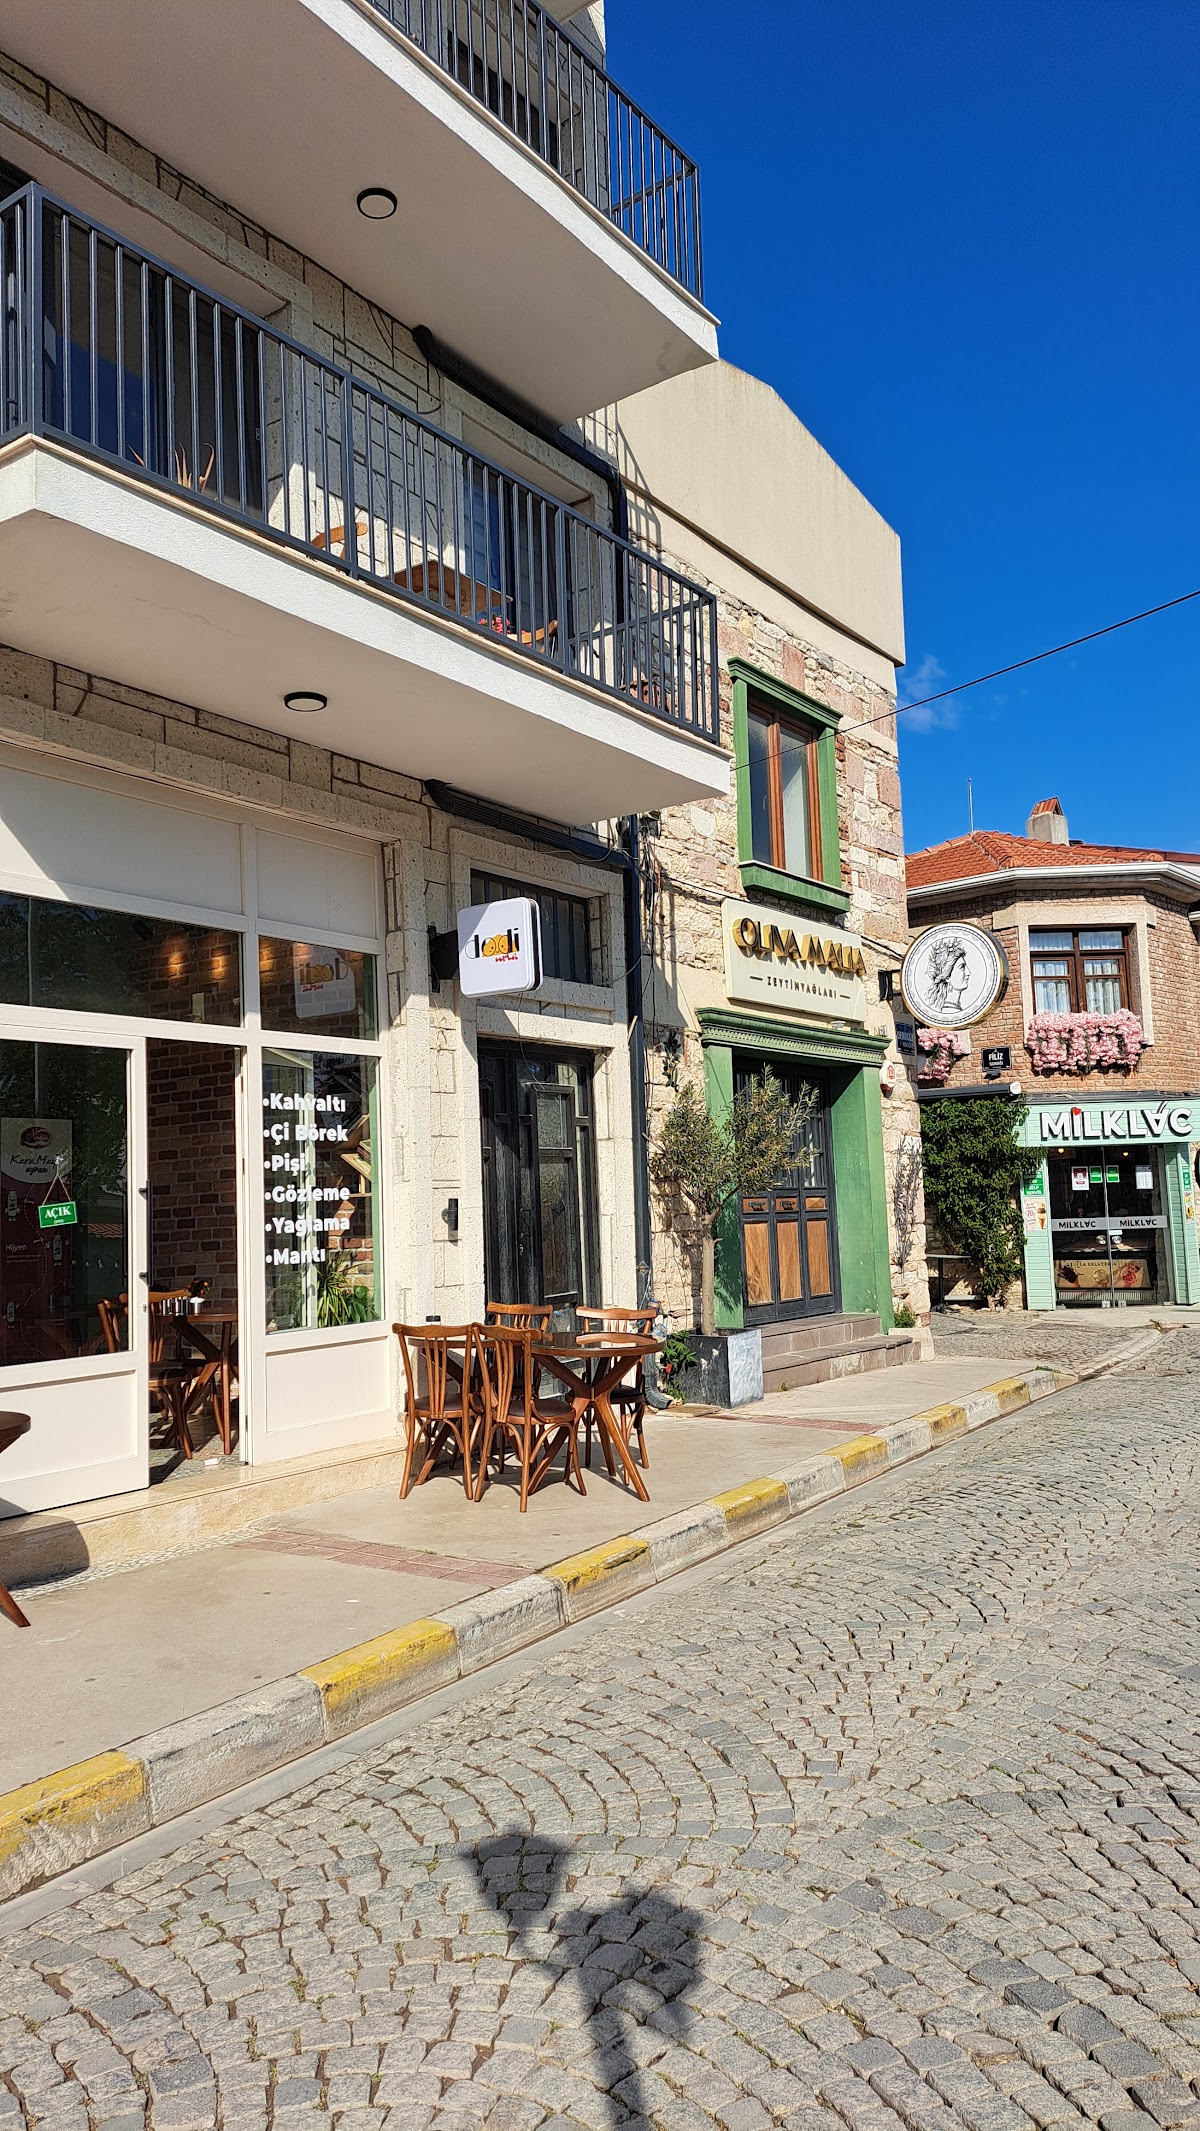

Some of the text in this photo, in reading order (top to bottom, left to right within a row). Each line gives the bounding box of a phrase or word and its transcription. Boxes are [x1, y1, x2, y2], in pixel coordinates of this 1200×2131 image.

[767, 976, 837, 999] ZEYTİNYAĞLARI
[988, 1052, 1004, 1061] FİLİZ
[270, 1093, 346, 1112] Kahvaltı
[270, 1122, 349, 1145] Çi Börek
[271, 1152, 306, 1176] Pişi
[272, 1184, 350, 1202] Gözleme
[44, 1206, 72, 1220] AÇIK
[272, 1215, 350, 1237] Yağlama
[5, 1243, 27, 1253] Hijyen
[273, 1248, 326, 1266] Mantı
